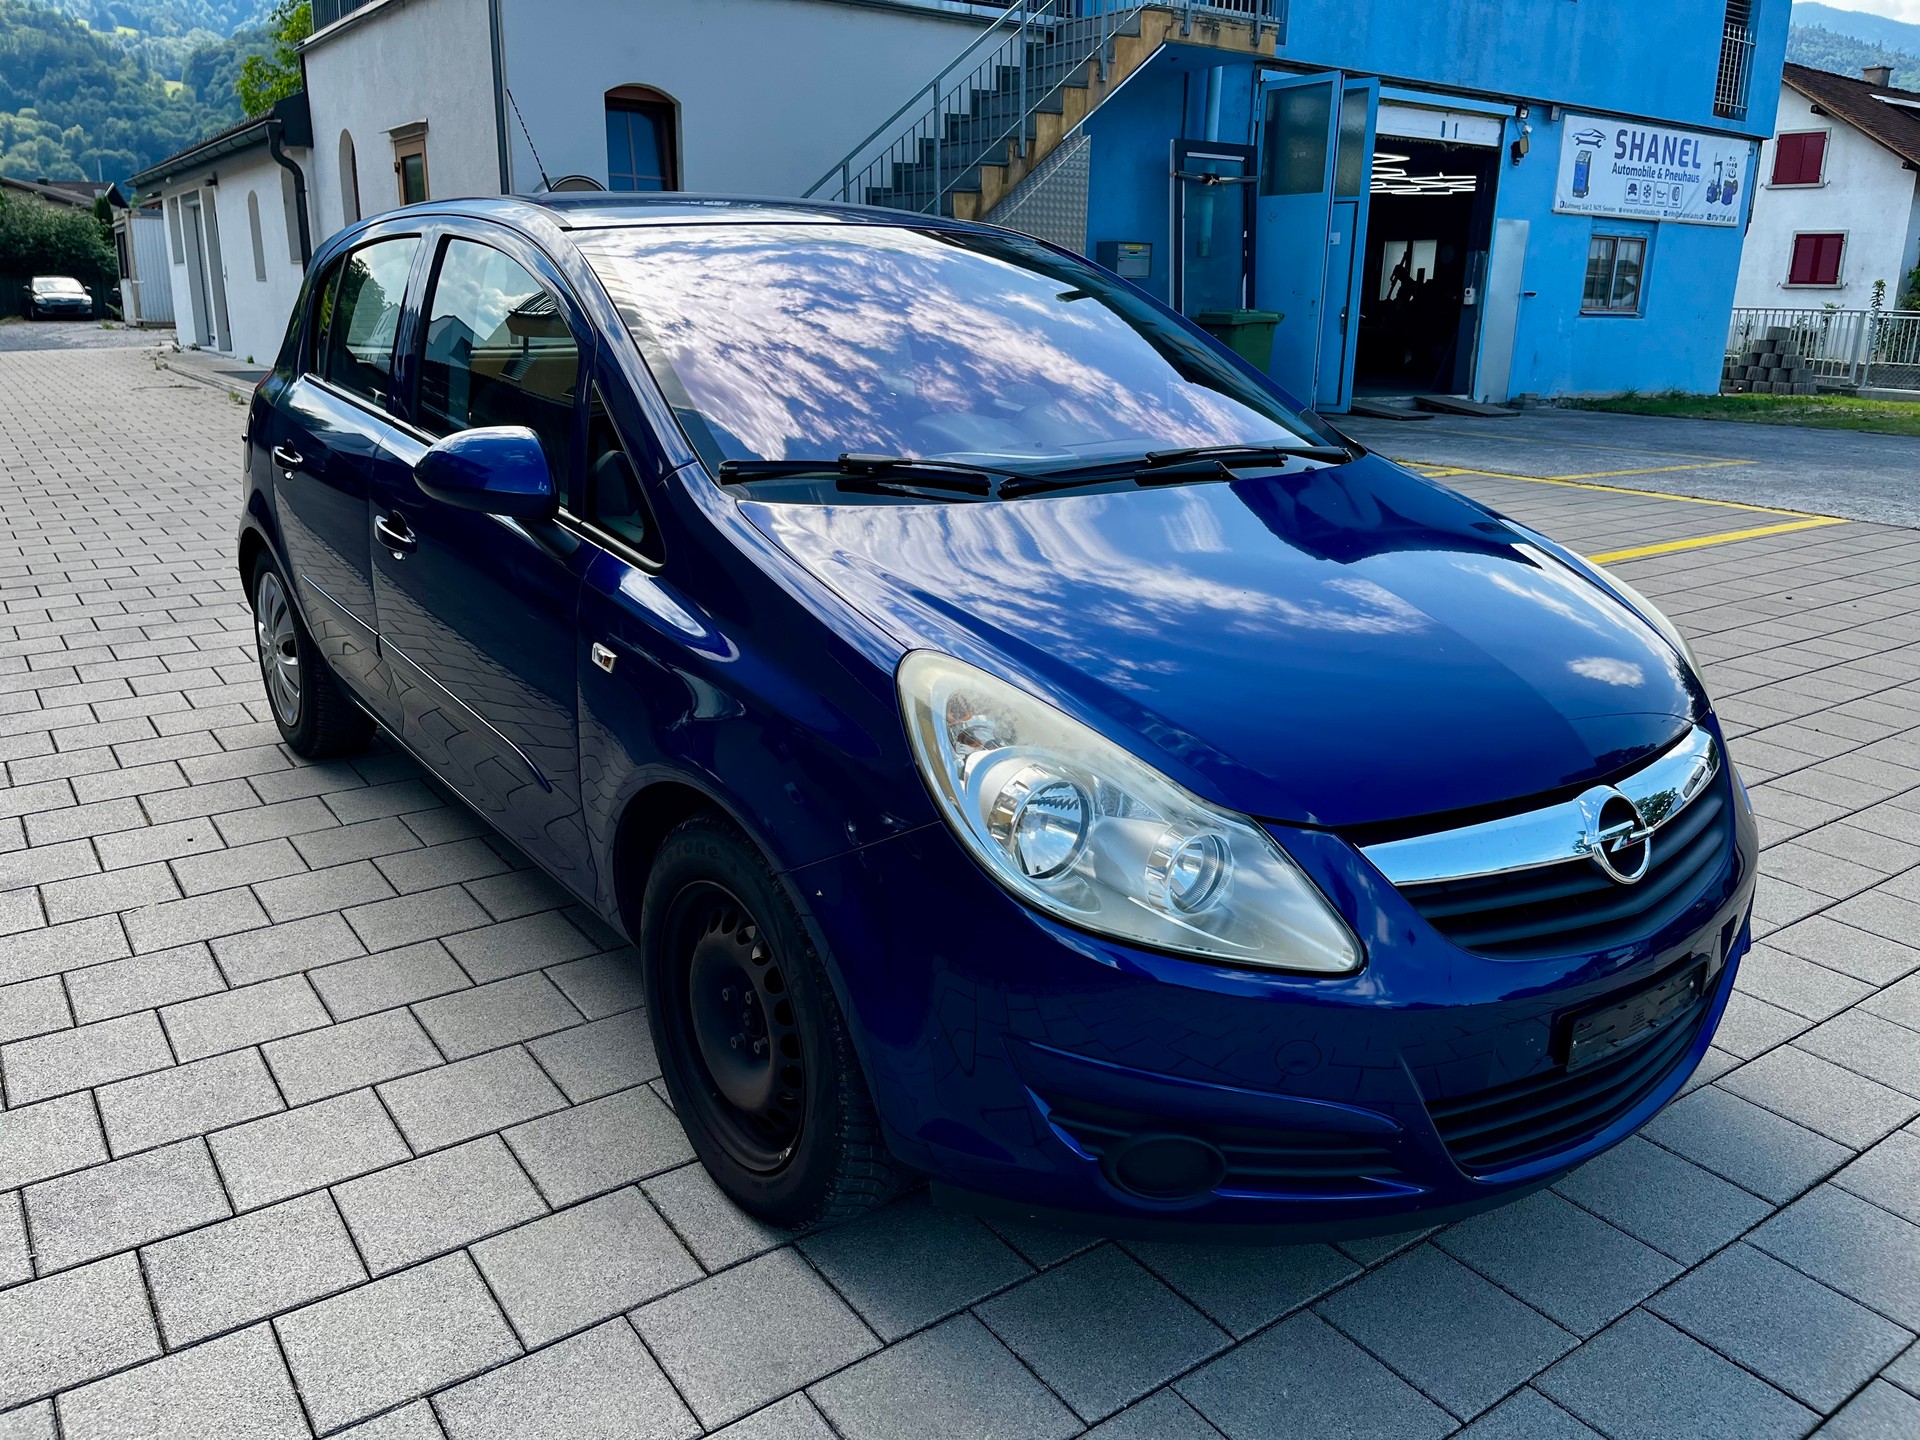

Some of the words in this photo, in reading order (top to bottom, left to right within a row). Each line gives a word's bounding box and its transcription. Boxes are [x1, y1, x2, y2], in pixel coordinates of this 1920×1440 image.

[1614, 129, 1701, 169] SHANEL
[1612, 162, 1656, 179] Automobile
[1657, 167, 1663, 179] &
[1664, 168, 1700, 183] Pneuhaus
